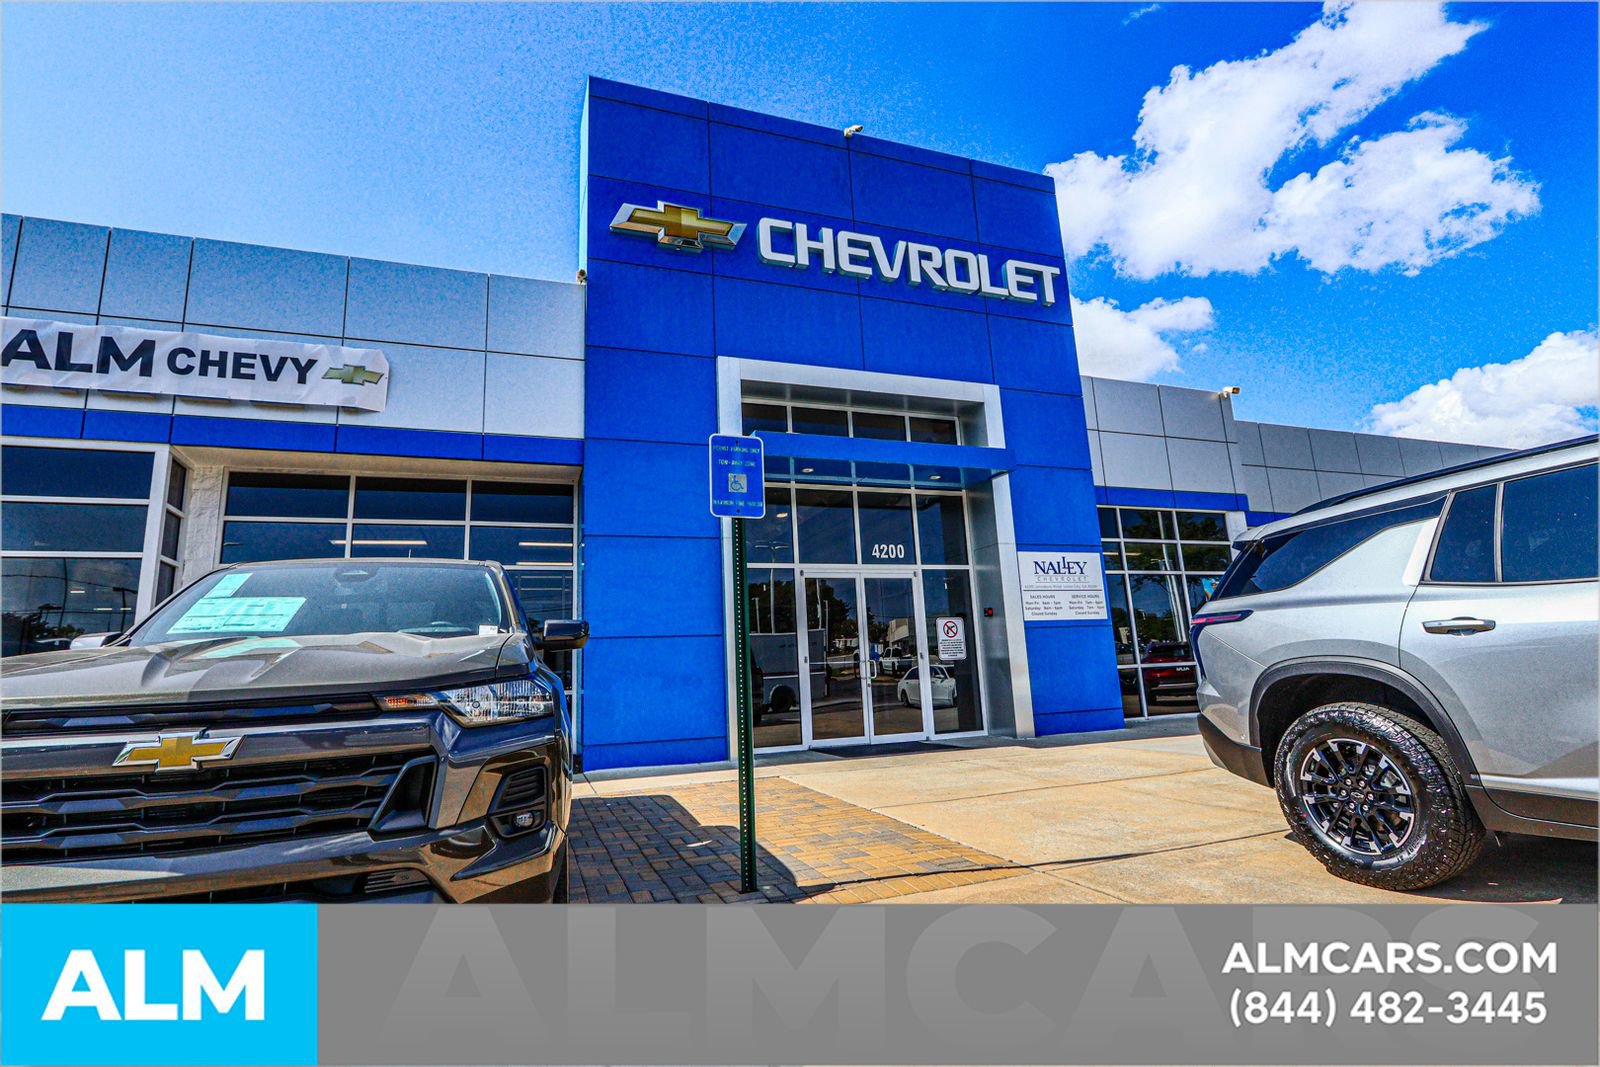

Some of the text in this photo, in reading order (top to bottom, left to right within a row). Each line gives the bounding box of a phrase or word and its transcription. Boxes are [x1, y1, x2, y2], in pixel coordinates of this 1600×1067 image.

[758, 217, 1060, 307] CHEVROLET
[1, 329, 318, 385] ALM CHEVY
[872, 544, 905, 559] 4200
[1033, 556, 1087, 575] NALLEY
